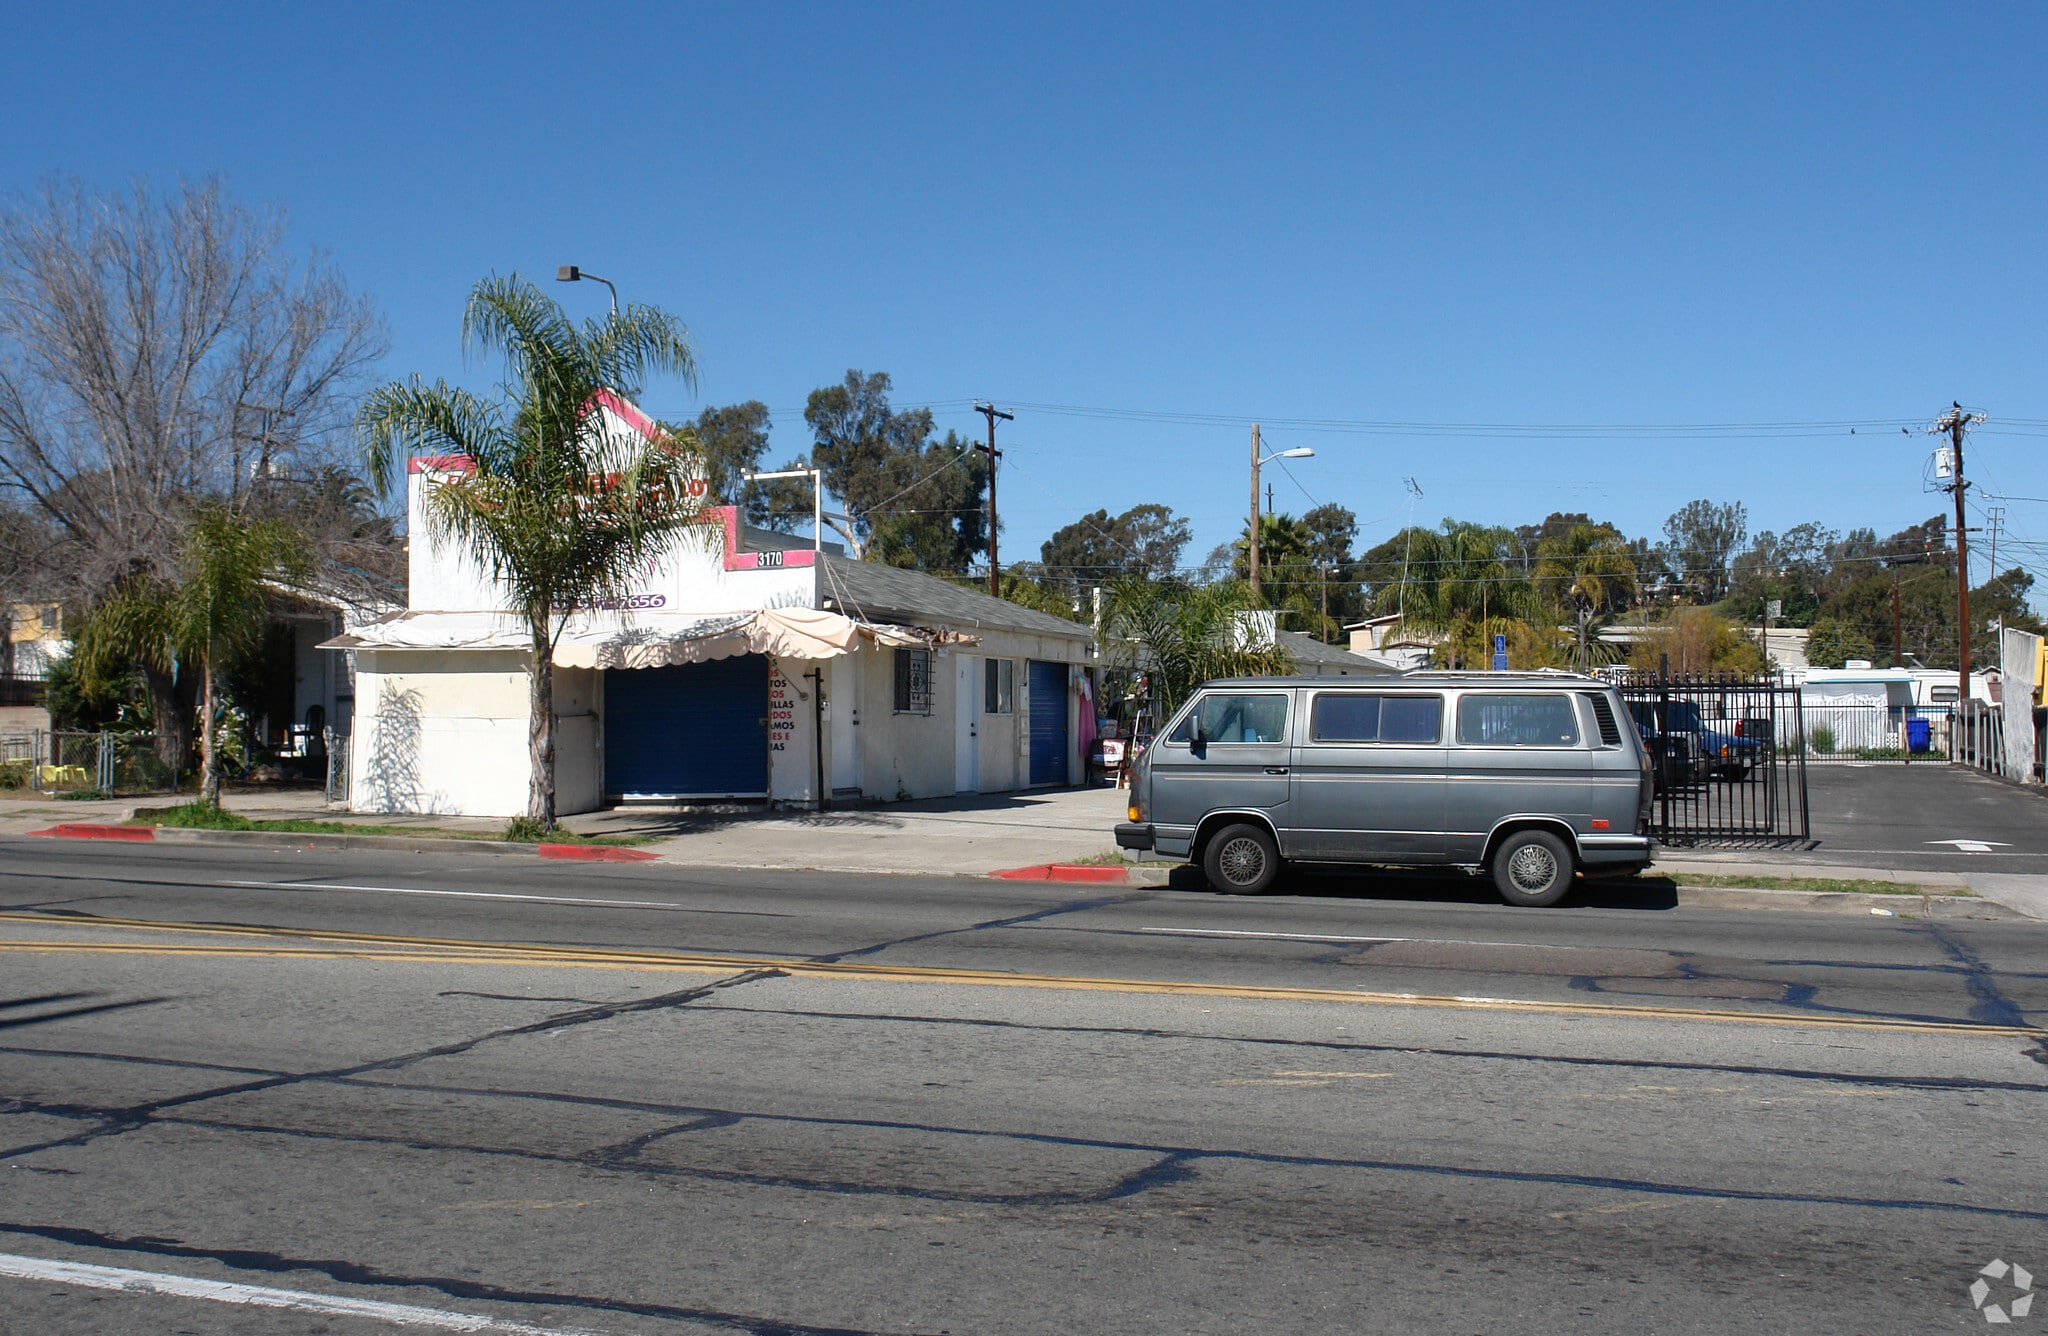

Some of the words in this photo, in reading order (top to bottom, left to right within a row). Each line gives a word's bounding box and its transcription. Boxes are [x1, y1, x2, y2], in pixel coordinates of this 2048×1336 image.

[758, 551, 782, 566] 3170
[770, 711, 792, 719] DOS
[770, 732, 783, 740] ES
